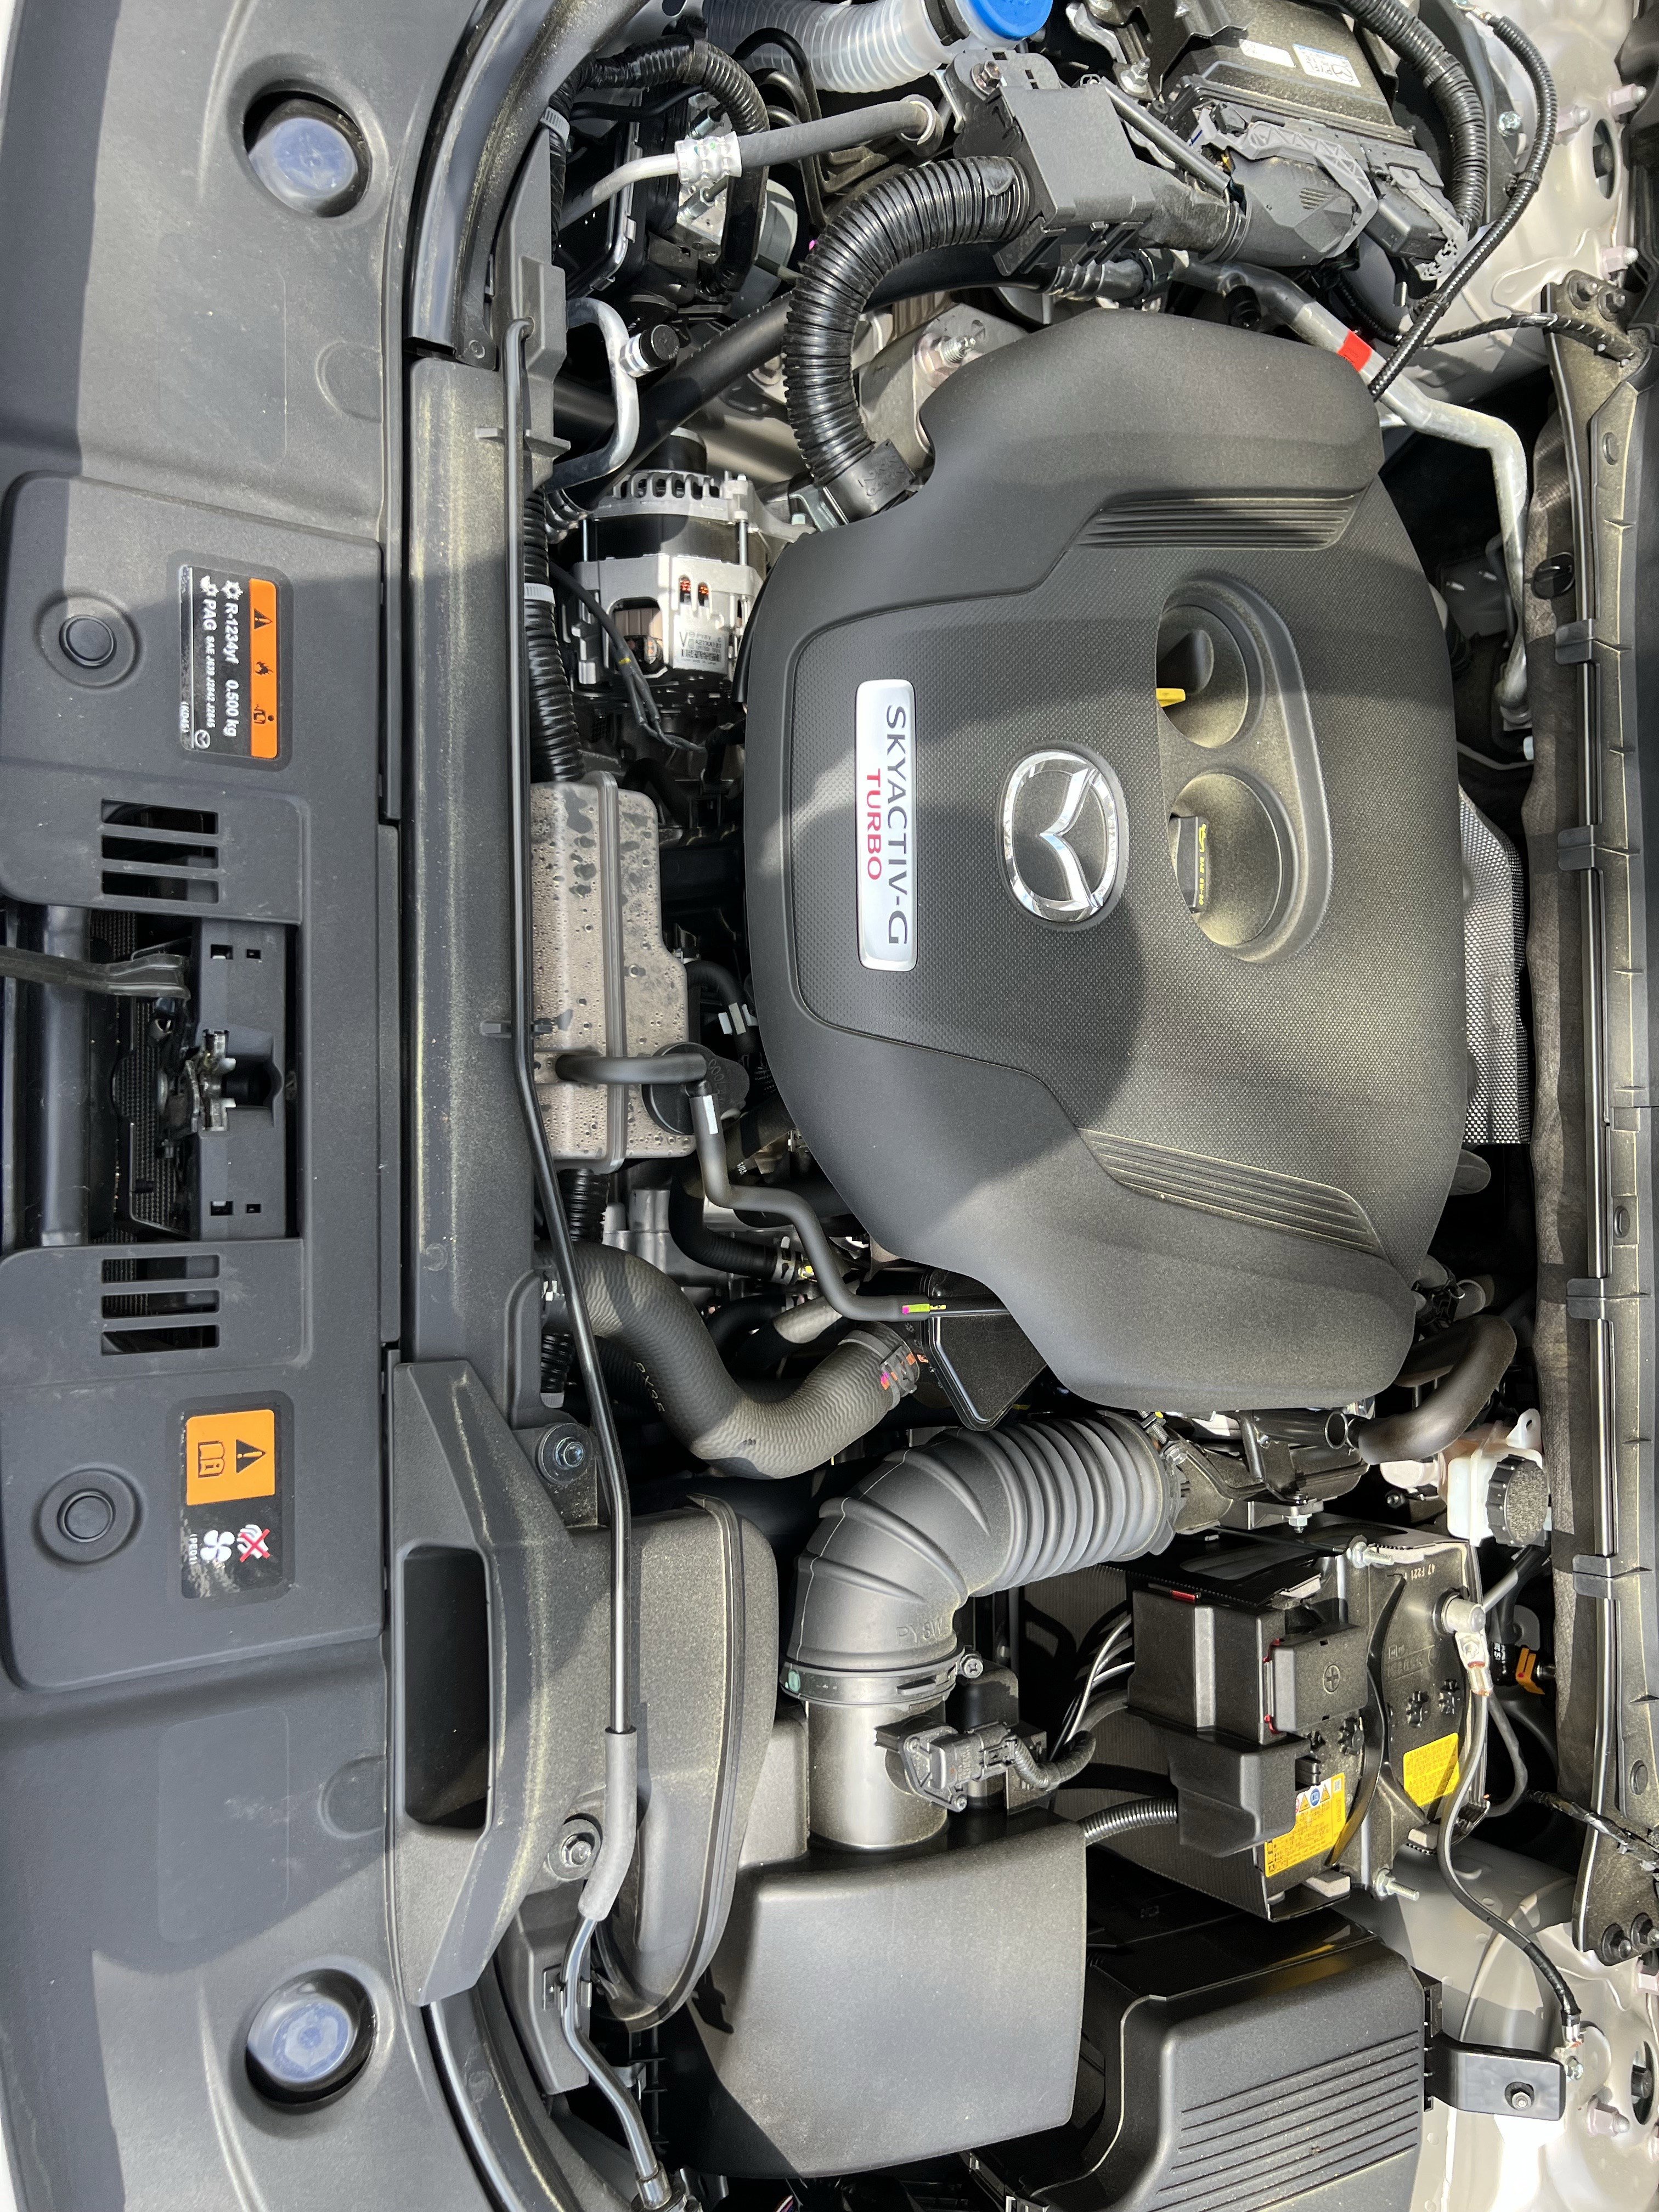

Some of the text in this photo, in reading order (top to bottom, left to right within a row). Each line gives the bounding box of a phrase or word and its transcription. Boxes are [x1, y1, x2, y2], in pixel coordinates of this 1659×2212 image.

[179, 701, 189, 733] (KD45)
[202, 599, 217, 728] PAG SAE J639 J2842 J2845
[223, 602, 240, 737] R-1234yf 0.500 kg
[866, 768, 882, 880] TURBO
[887, 706, 907, 944] SKYACTIV-G
[188, 1533, 198, 1565] (PE01)
